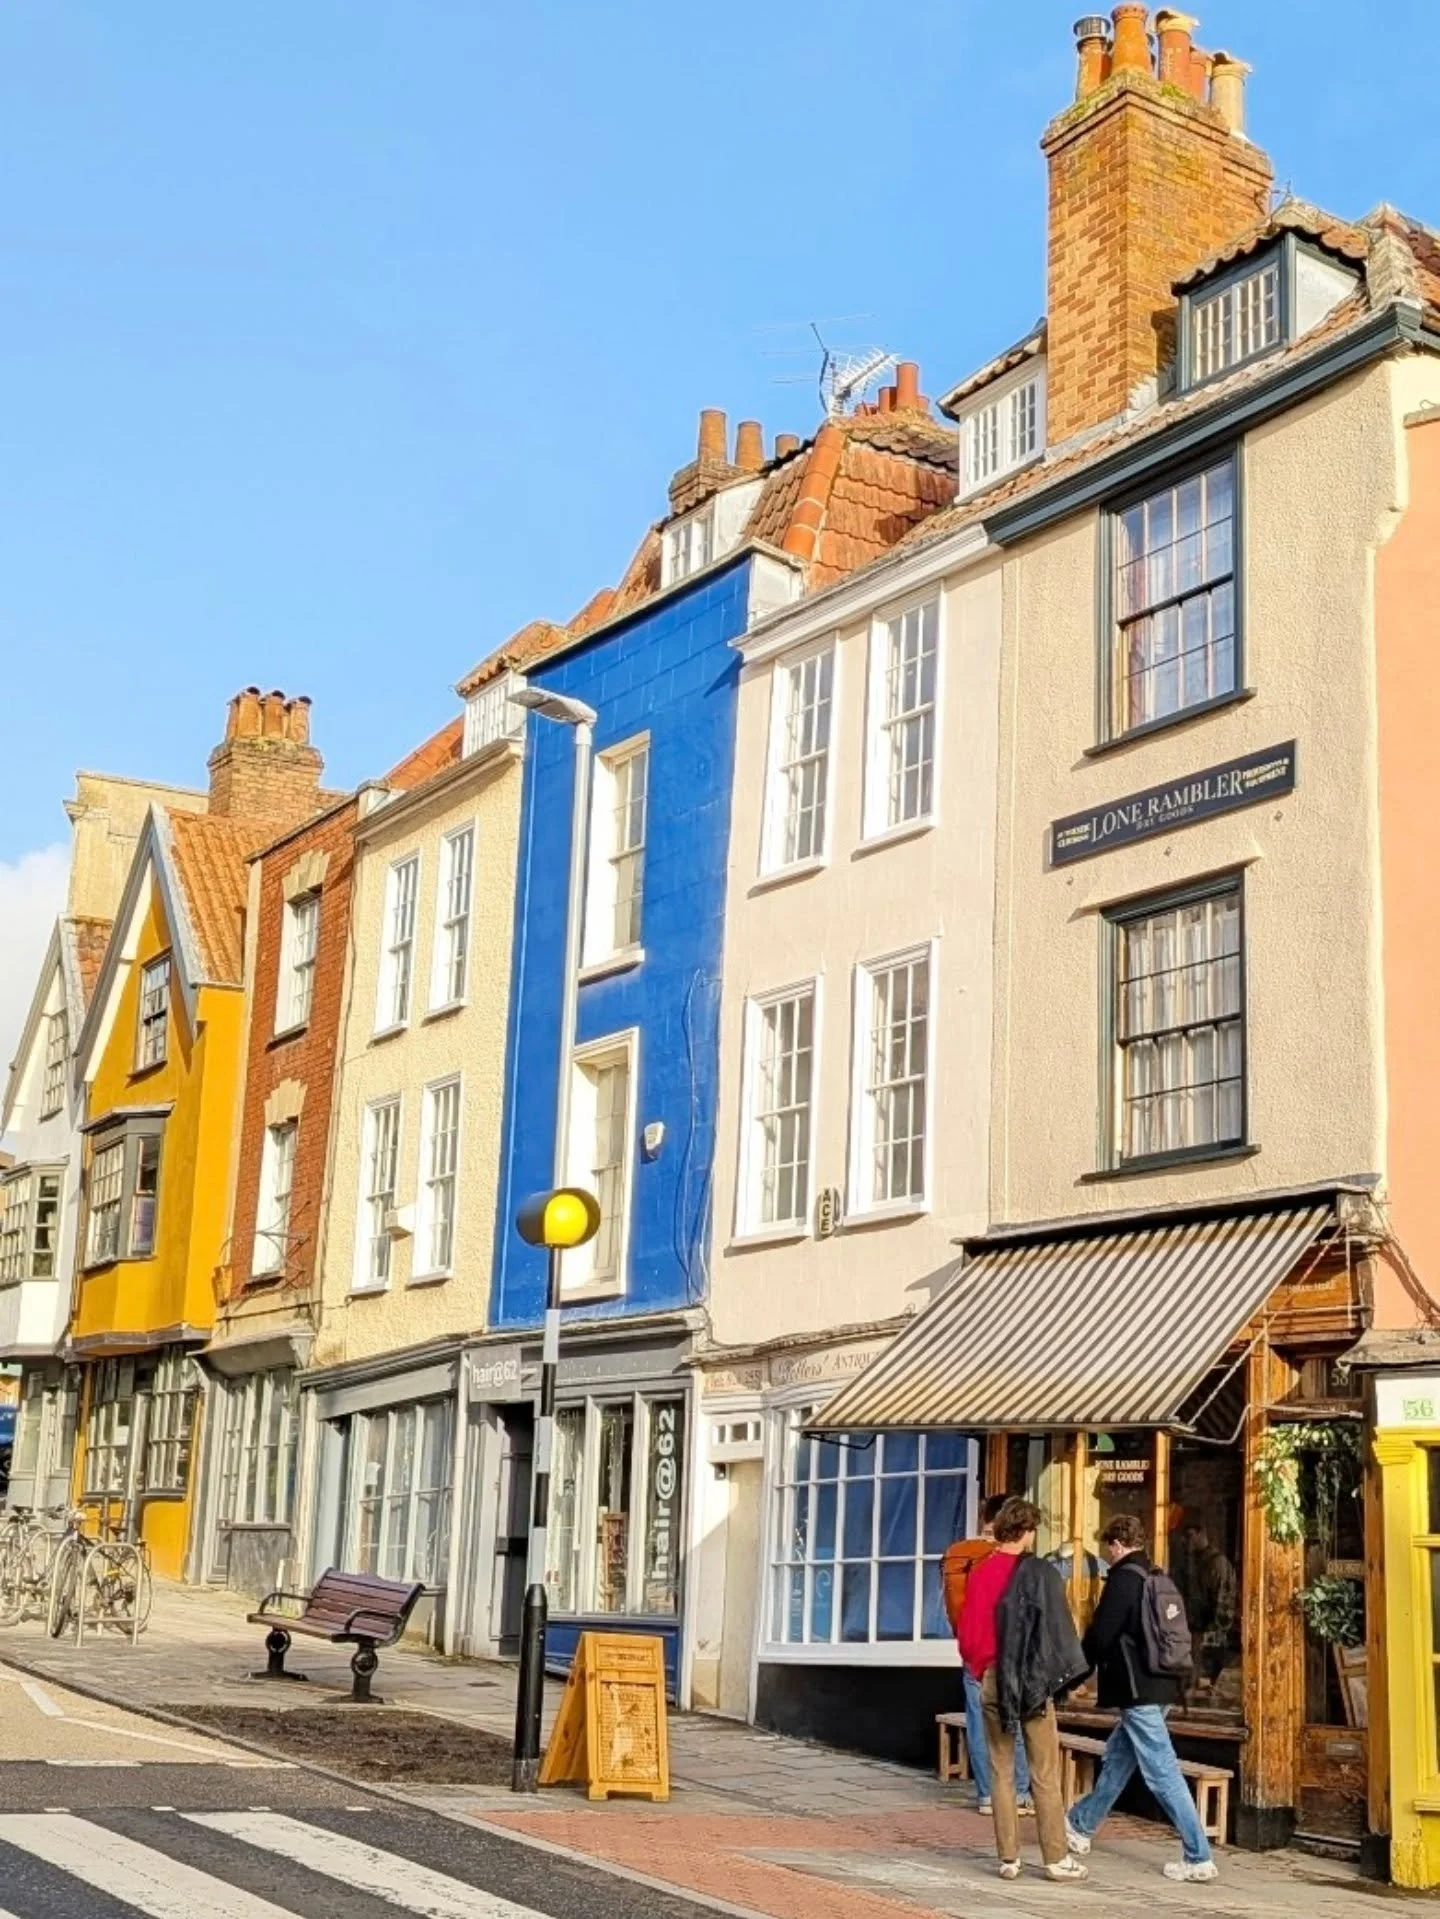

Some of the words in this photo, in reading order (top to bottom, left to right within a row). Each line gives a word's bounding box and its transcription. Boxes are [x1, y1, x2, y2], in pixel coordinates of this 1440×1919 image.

[1091, 802, 1143, 843] LONE
[1148, 769, 1244, 817] RAMBLER
[1135, 817, 1155, 831] DRY
[1158, 804, 1194, 823] GOODS
[472, 1360, 517, 1387] hair@62
[1405, 1399, 1433, 1417] 56
[1117, 1471, 1144, 1483] GOODS
[651, 1408, 676, 1579] hair@62
